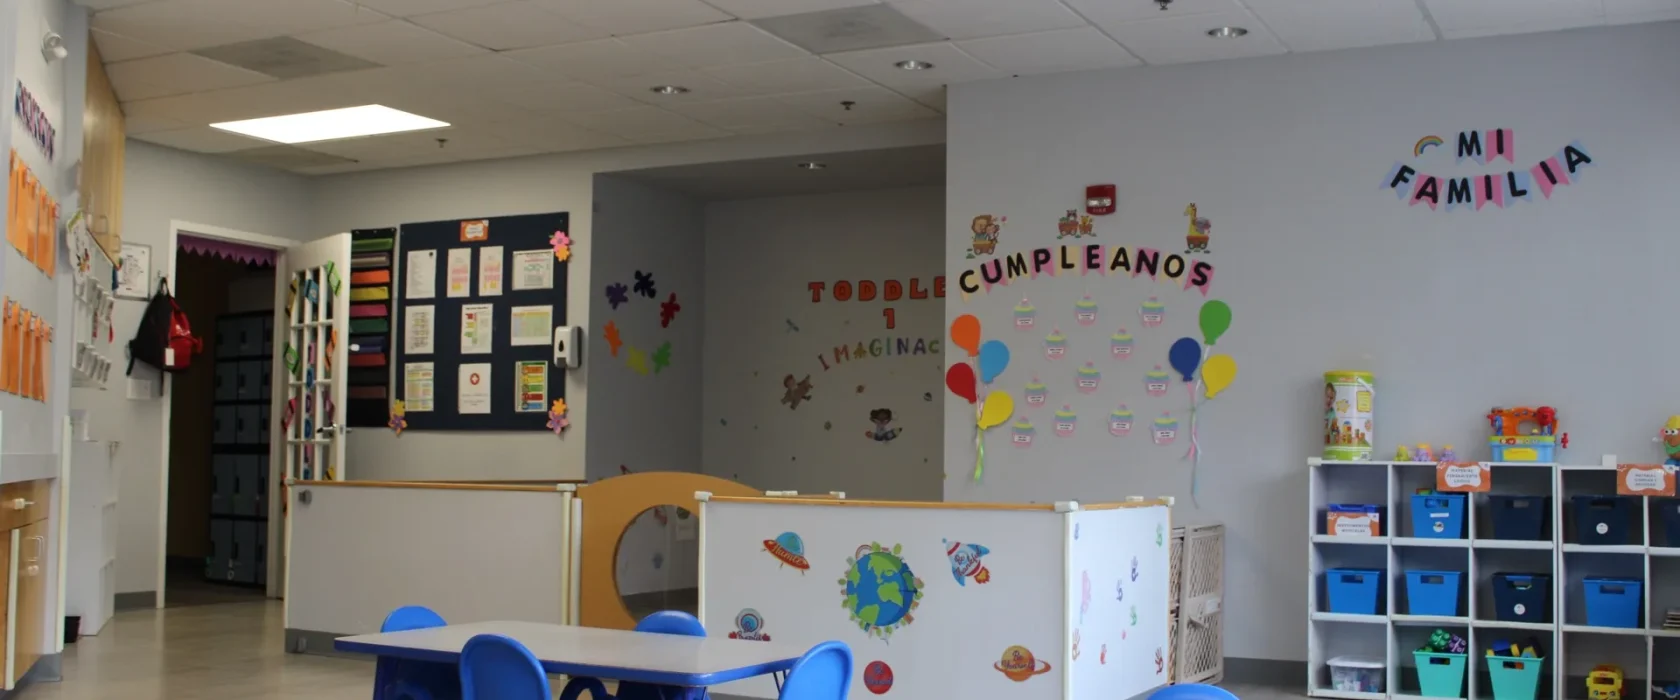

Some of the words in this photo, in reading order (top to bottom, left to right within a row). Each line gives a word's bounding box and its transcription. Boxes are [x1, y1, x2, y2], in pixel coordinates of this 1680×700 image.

[1458, 128, 1504, 157] MI
[1390, 145, 1592, 204] FAMILIA
[959, 244, 1213, 293] CUMPLEANOS
[808, 276, 946, 302] TODDLE
[882, 307, 896, 330] 1
